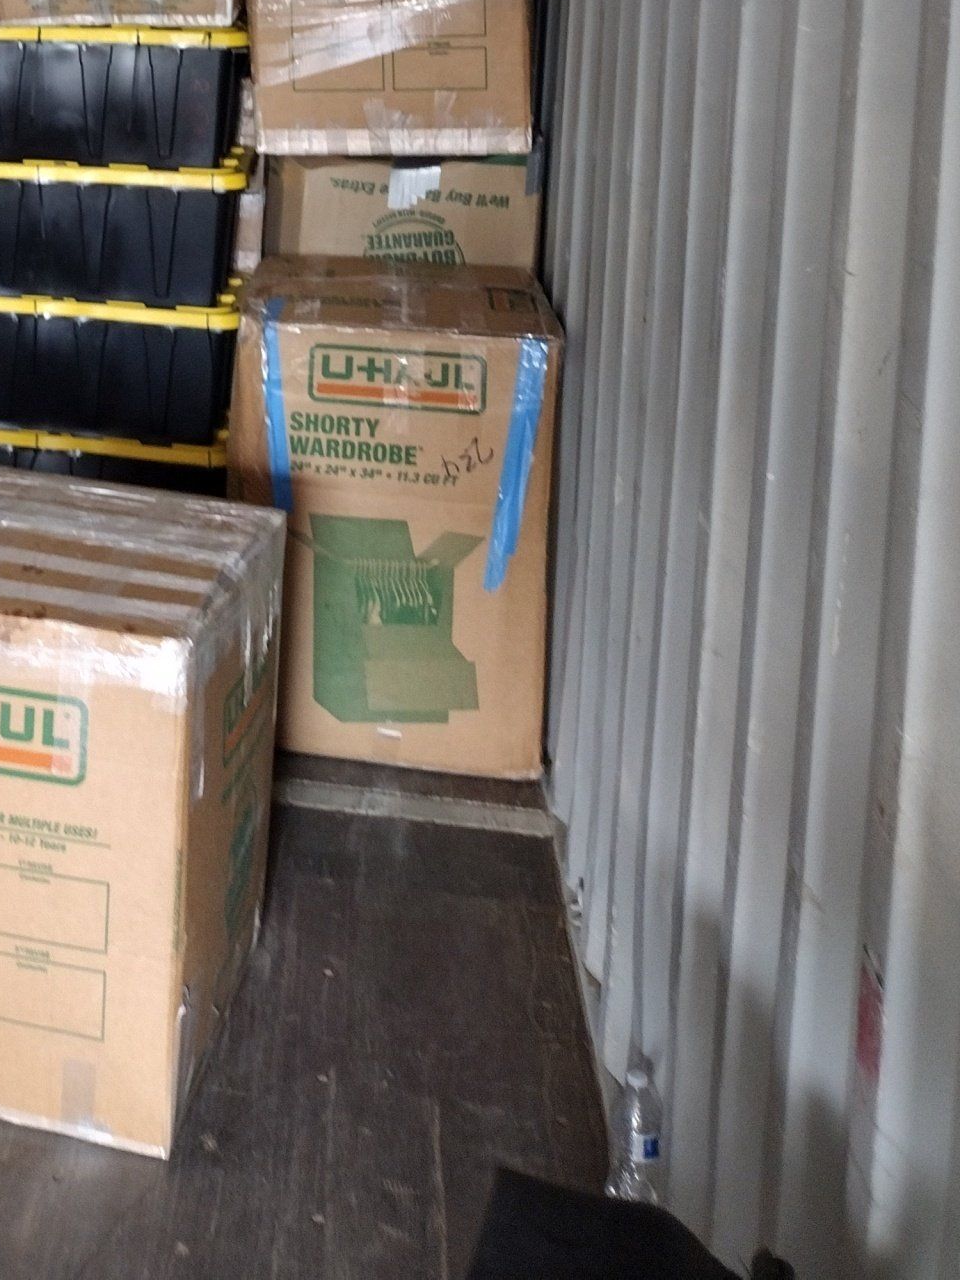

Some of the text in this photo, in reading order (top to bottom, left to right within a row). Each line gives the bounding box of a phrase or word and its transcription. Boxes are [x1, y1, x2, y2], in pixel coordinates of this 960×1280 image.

[367, 229, 455, 250] GUARANTEE
[290, 411, 380, 438] SHORTY
[290, 435, 418, 466] WARDROBE
[9, 814, 61, 833] MULTIPLE
